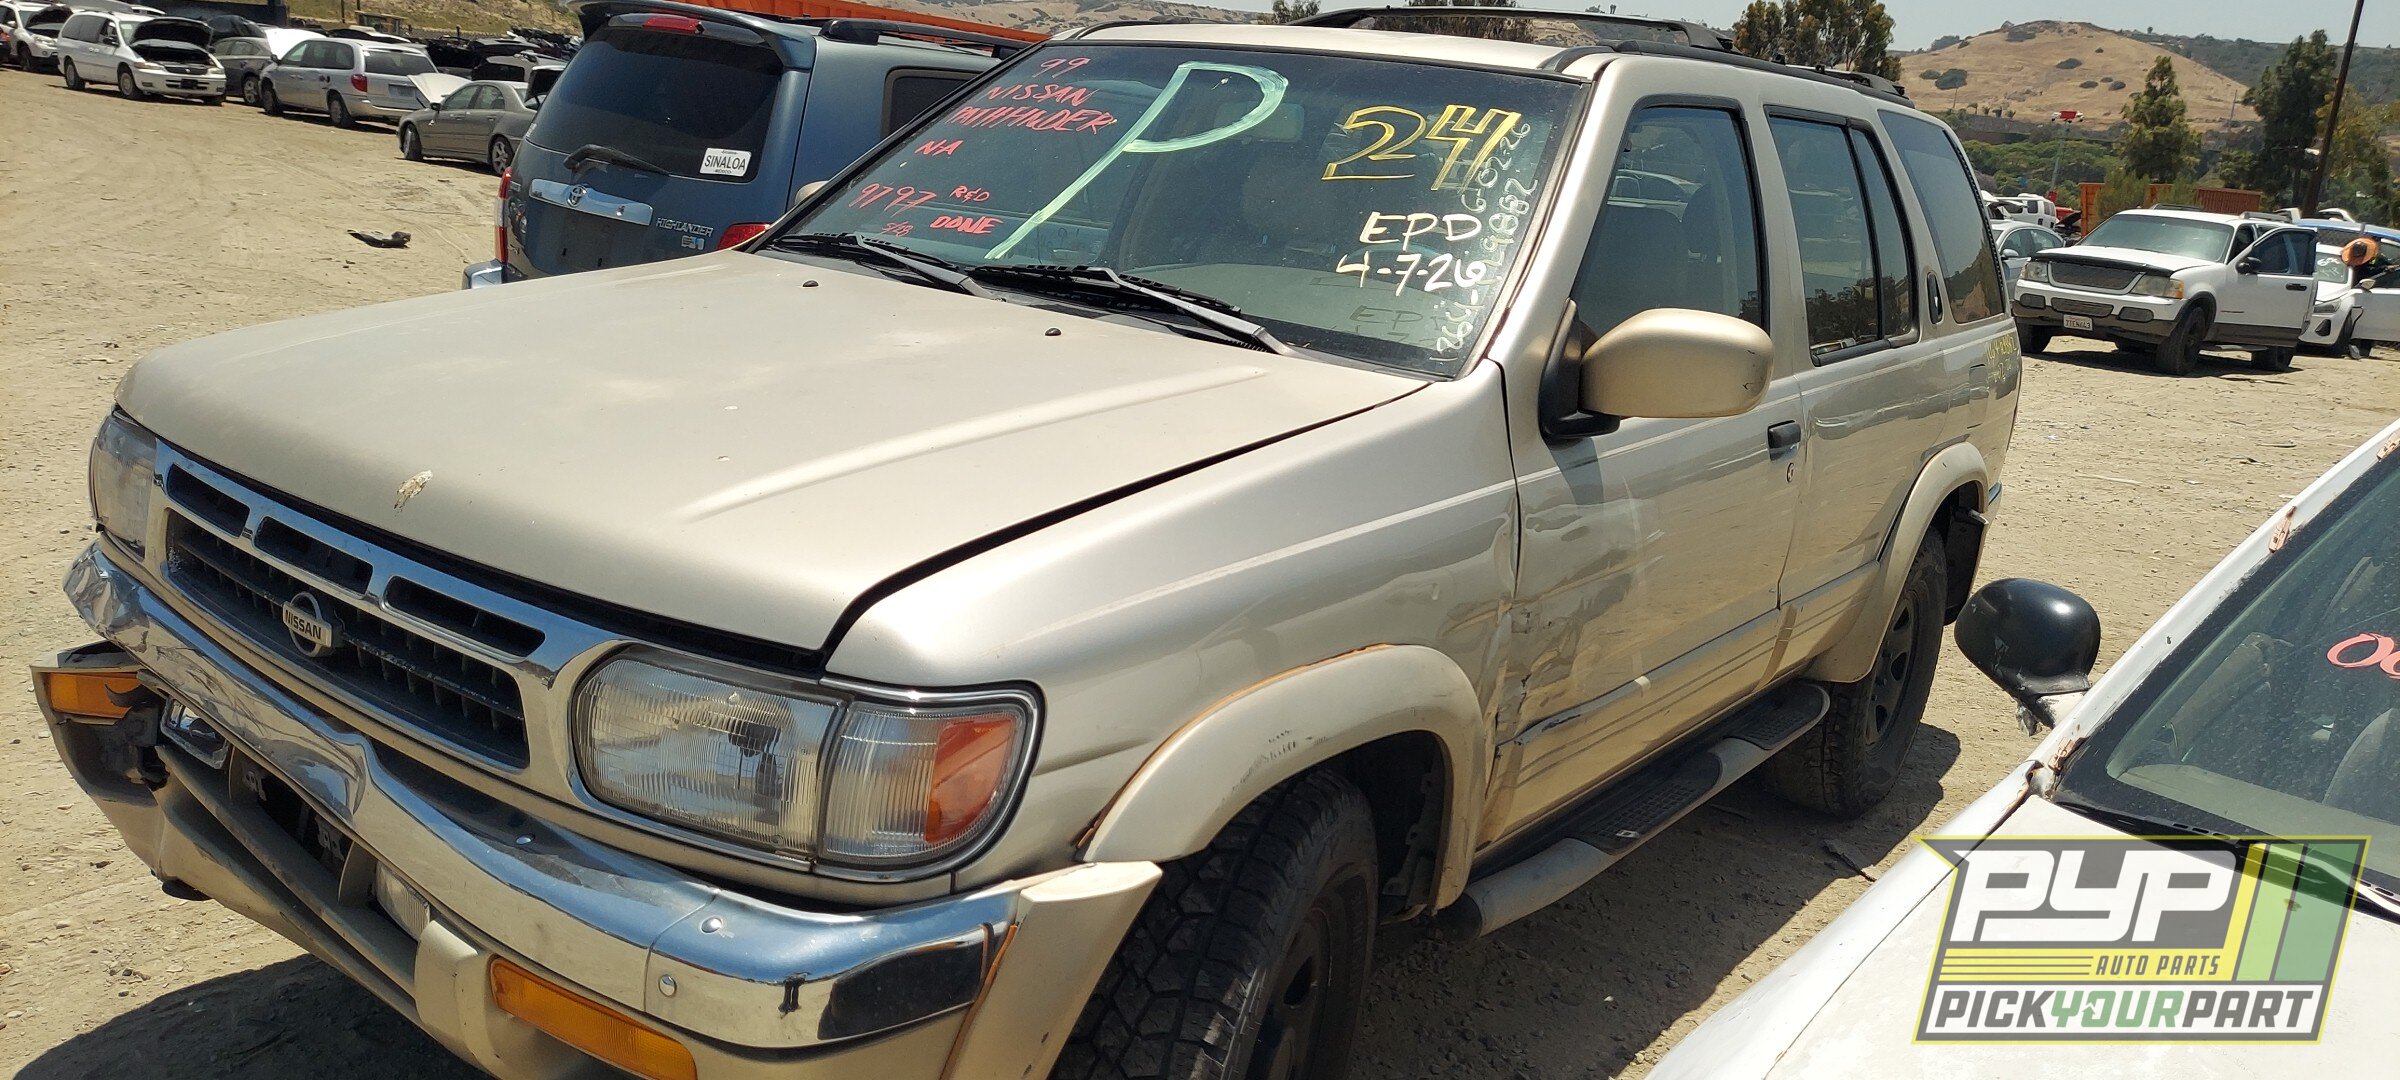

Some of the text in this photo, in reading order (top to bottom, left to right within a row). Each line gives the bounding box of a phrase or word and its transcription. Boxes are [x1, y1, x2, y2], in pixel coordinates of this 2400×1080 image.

[1032, 57, 1091, 79] 99
[978, 84, 1099, 107] NISSAN
[914, 139, 964, 156] NA
[1321, 104, 1522, 194] 24
[704, 154, 746, 171] SINALOA
[984, 61, 1289, 260] P
[656, 217, 714, 237] HIGHLANDER
[929, 215, 1004, 234] DONE
[1359, 211, 1483, 252] EPD
[1336, 251, 1487, 297] 4-7-26
[285, 609, 322, 640] NISSAN
